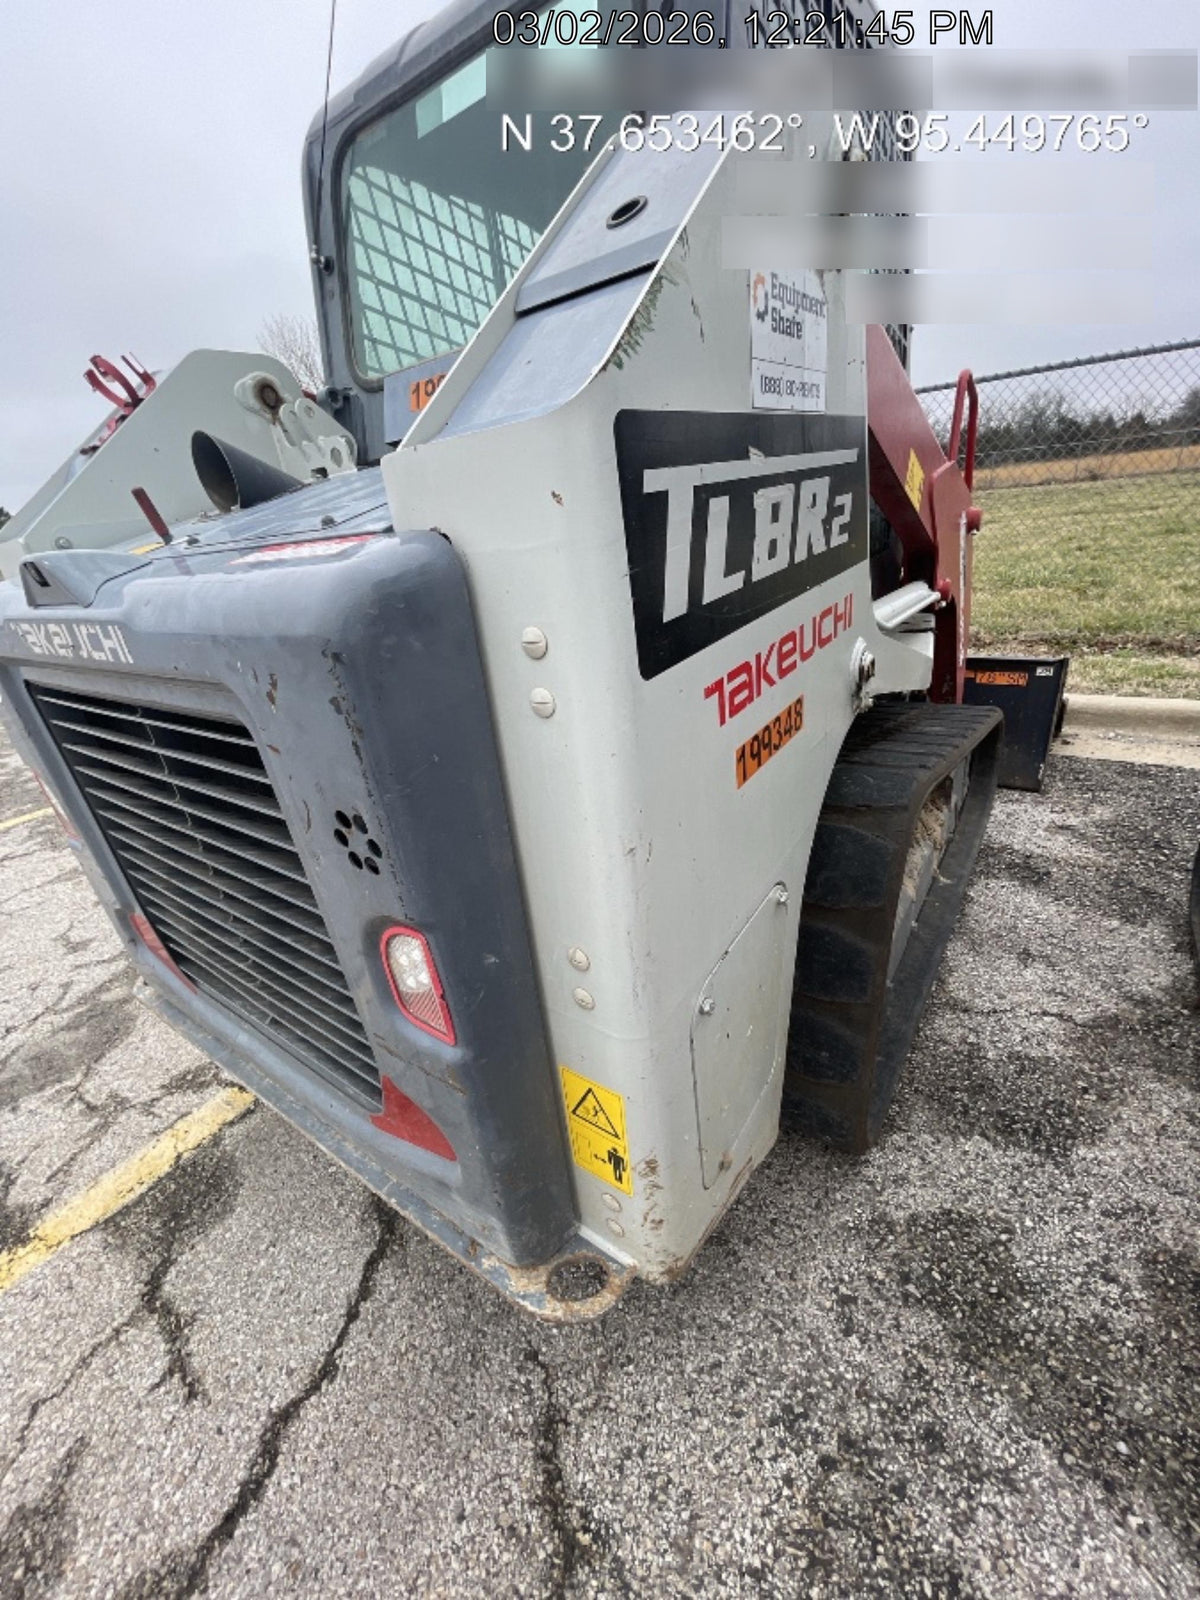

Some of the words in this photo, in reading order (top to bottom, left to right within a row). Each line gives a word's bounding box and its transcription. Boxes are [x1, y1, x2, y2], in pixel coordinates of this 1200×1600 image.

[770, 272, 826, 319] Equipment
[771, 307, 803, 340] Share
[704, 593, 853, 727] TAKEUCHI
[737, 697, 803, 784] 199348
